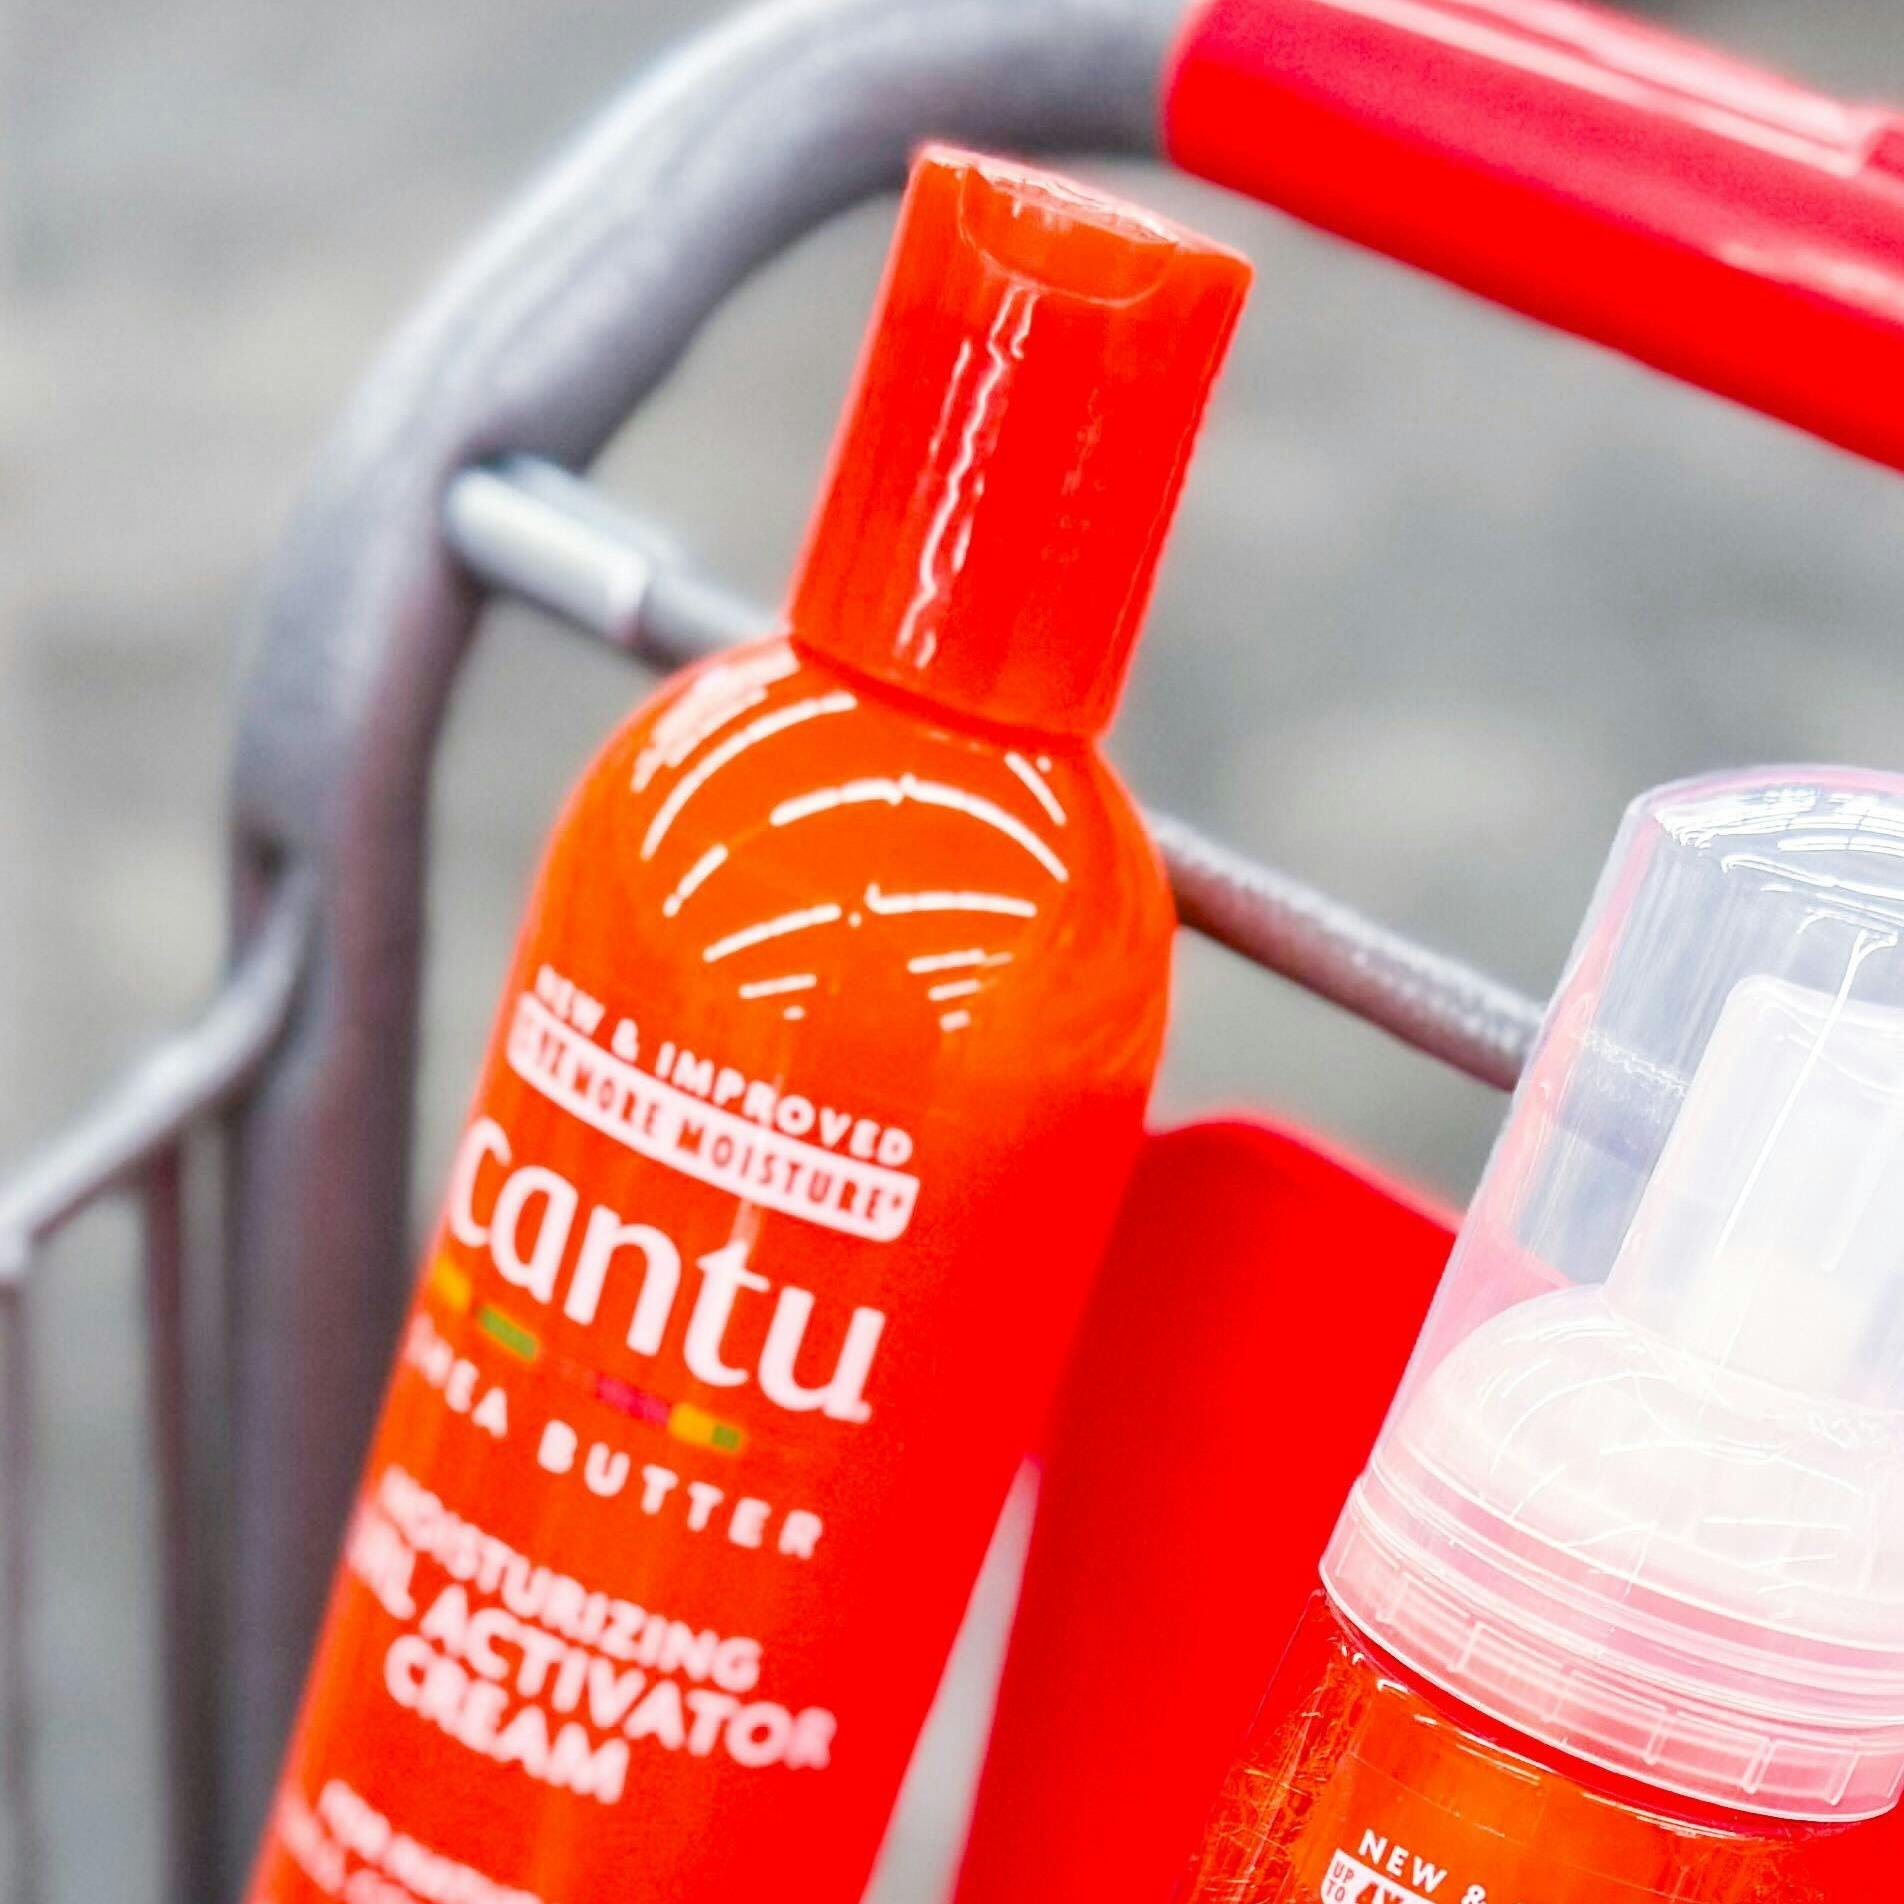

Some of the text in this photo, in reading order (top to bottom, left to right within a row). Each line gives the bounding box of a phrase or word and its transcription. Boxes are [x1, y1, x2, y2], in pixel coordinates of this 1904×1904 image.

[612, 1018, 638, 1062] &
[656, 1040, 913, 1167] IMPROVED
[449, 1116, 887, 1424] cantu
[538, 1419, 823, 1560] BUTTER
[384, 1634, 630, 1805] CREAM
[418, 1583, 837, 1770] ACTIVATOR
[1326, 1880, 1346, 1902] TO
[1333, 1860, 1354, 1883] UP
[1358, 1828, 1448, 1893] NEW
